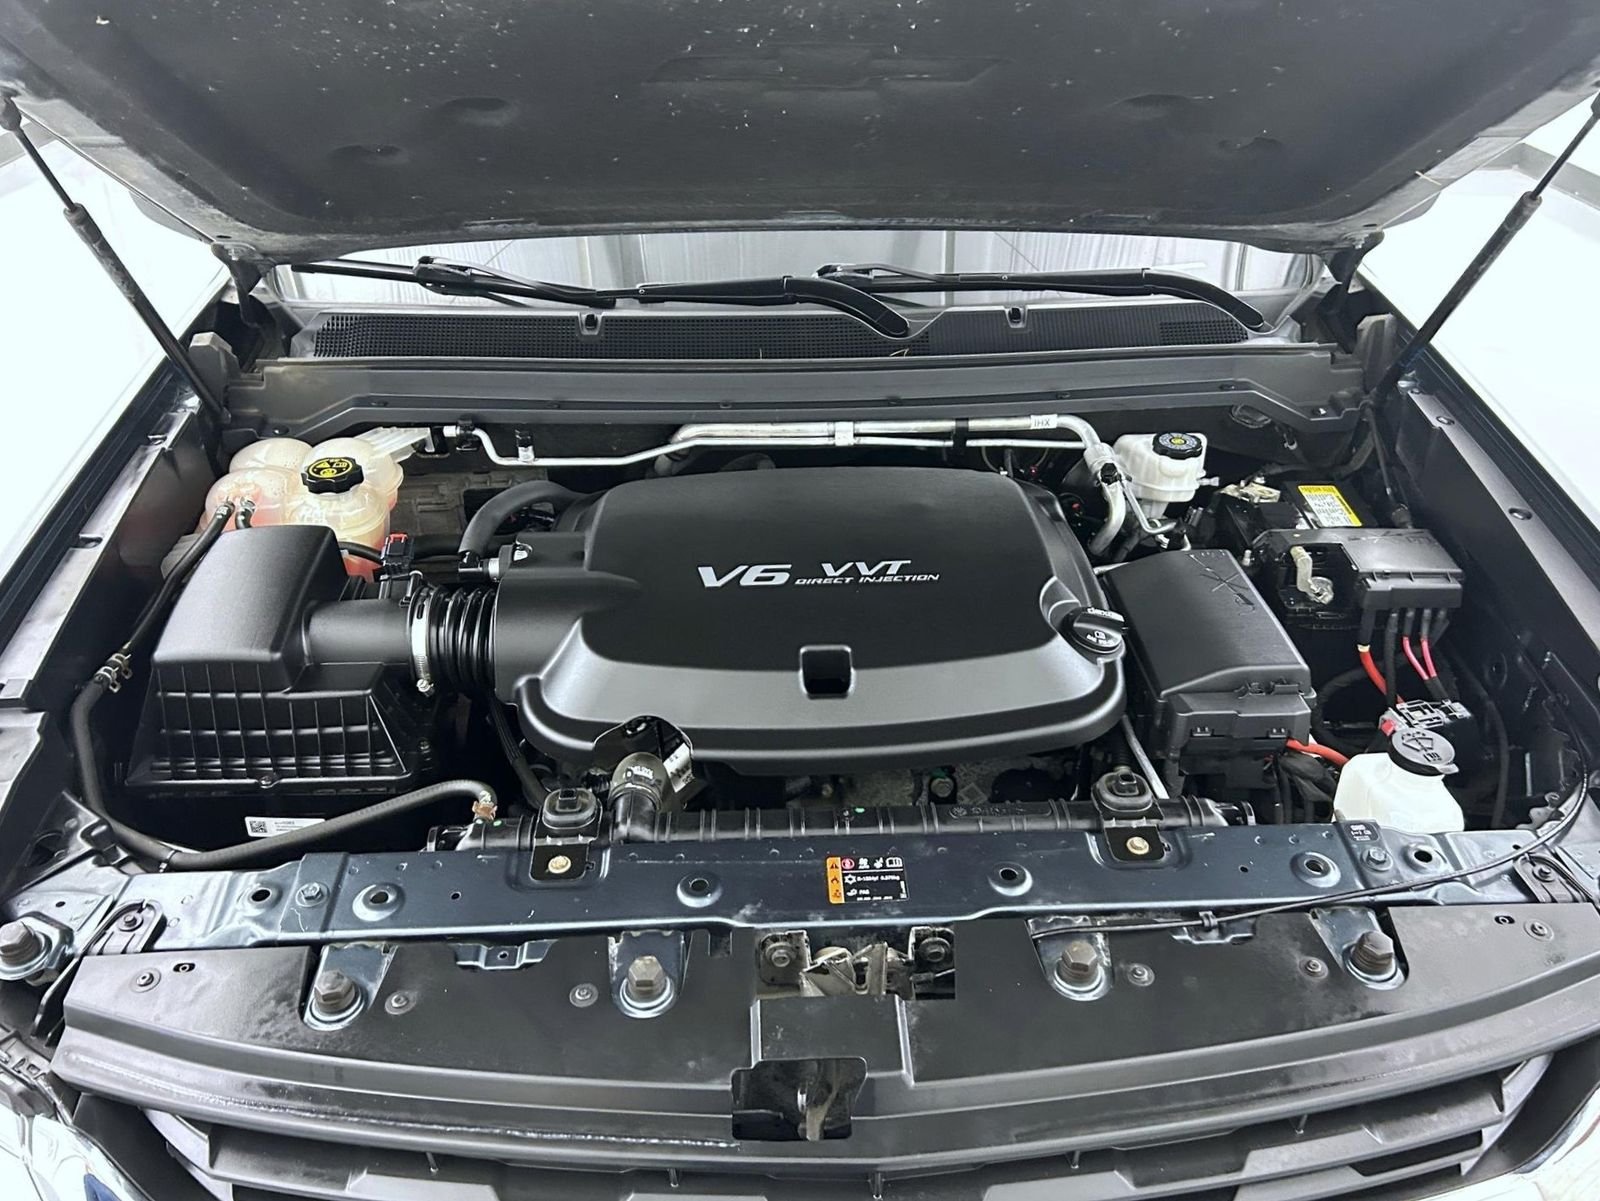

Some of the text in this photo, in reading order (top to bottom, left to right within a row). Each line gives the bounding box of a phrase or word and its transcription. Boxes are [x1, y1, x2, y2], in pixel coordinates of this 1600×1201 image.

[697, 559, 912, 588] V6 VVT
[795, 574, 940, 585] DIRECT INJECTION
